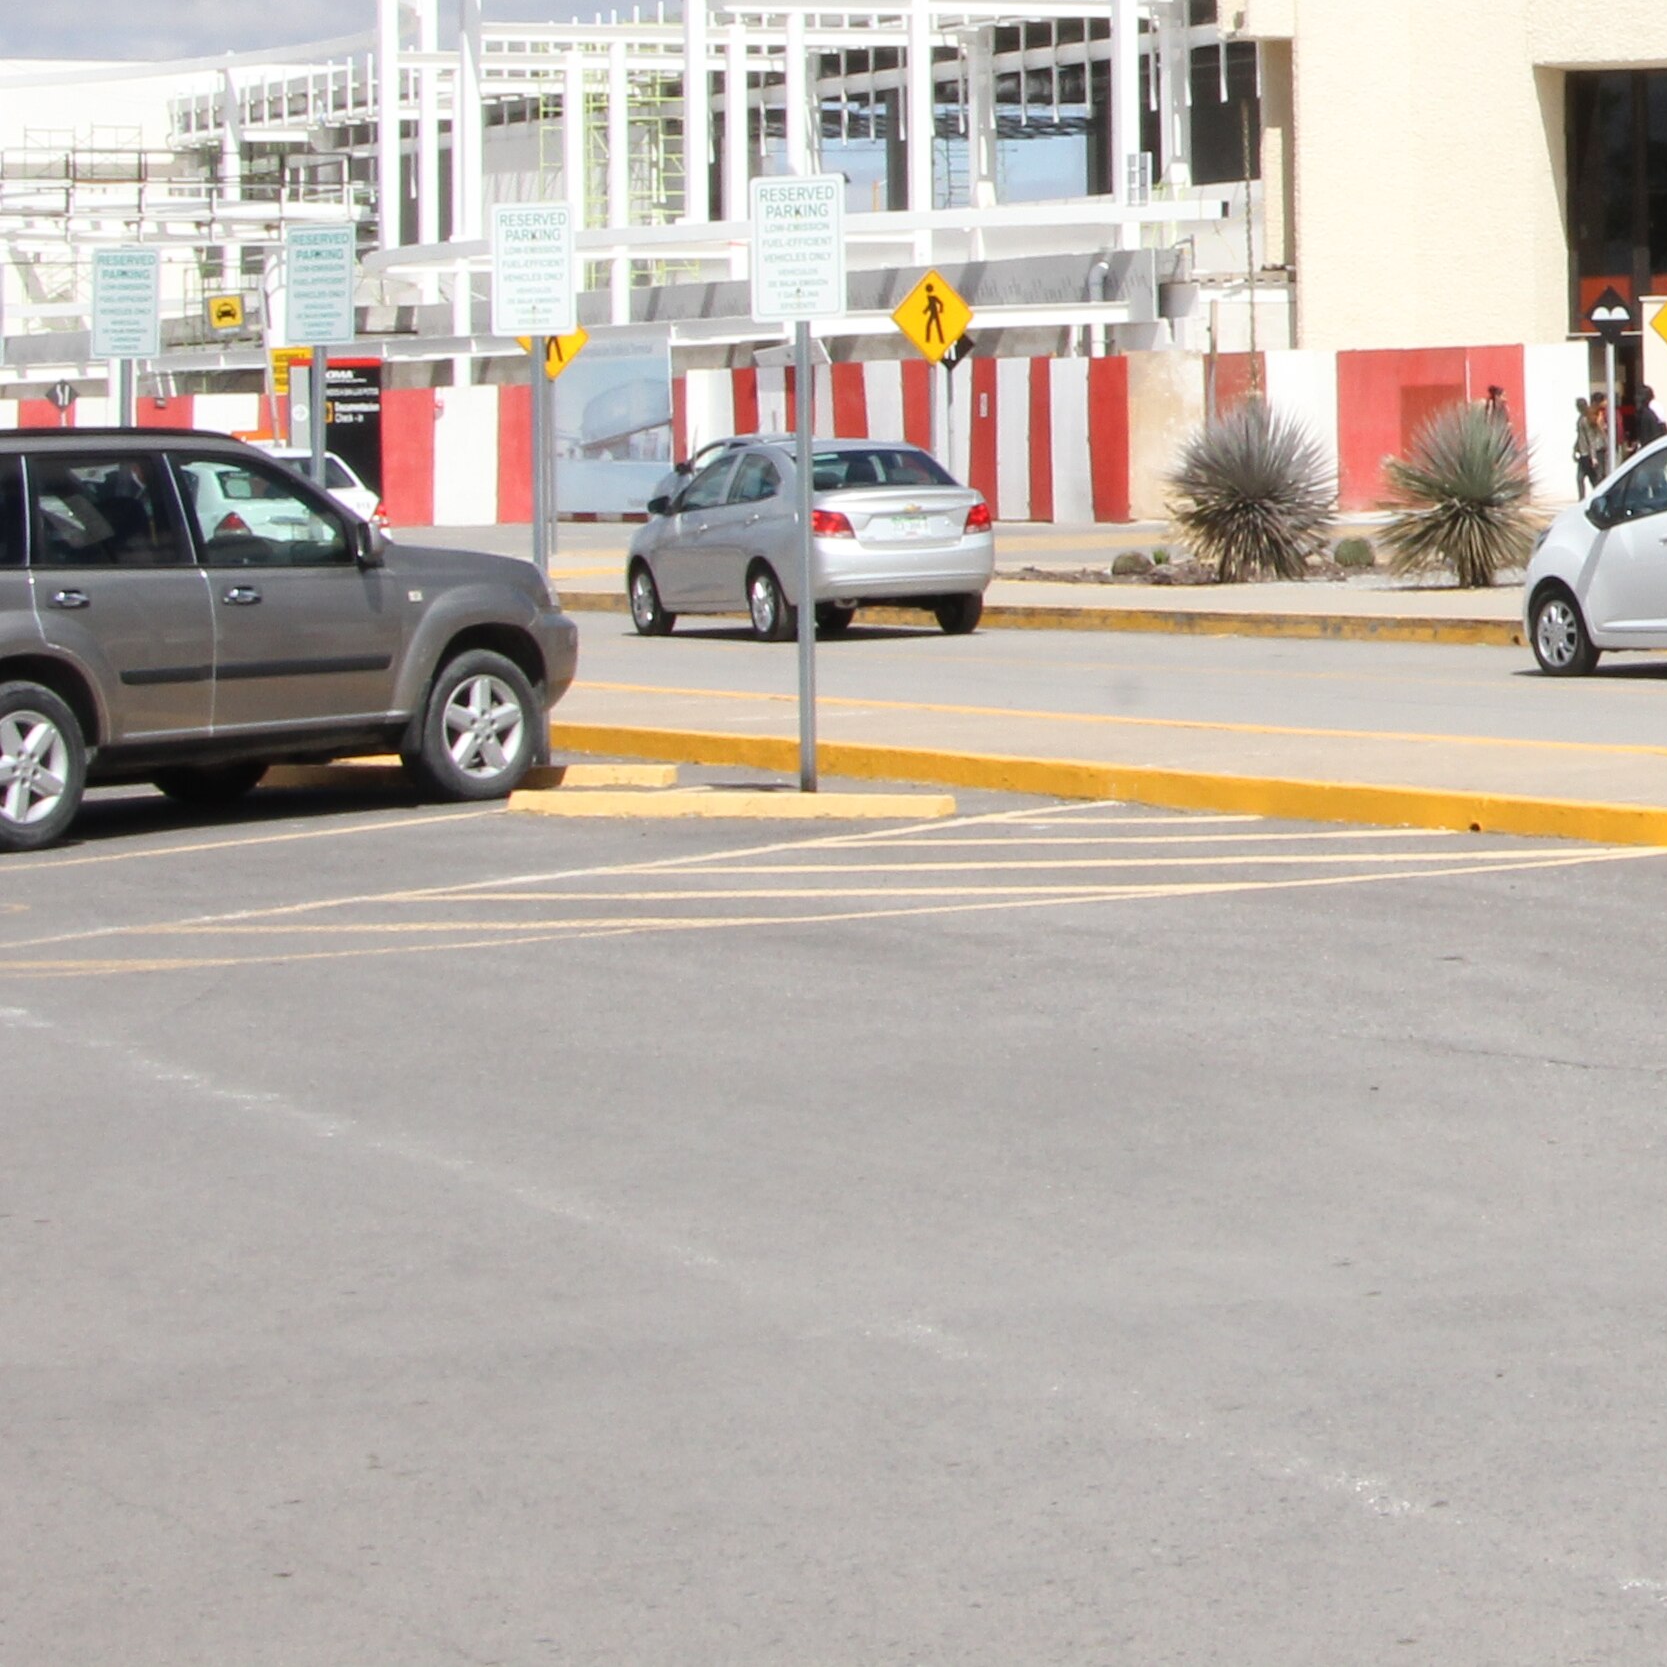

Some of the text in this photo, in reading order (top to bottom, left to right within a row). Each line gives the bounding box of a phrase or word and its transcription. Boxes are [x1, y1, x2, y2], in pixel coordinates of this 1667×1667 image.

[759, 185, 835, 202] RESERVED
[765, 203, 829, 219] PARKING
[499, 212, 567, 228] RESERVED
[764, 222, 830, 233] LOW-EMISSION
[290, 233, 350, 245] RESERVED
[504, 228, 562, 242] PARKING
[762, 236, 833, 248] FUEL-EFFICIENT
[763, 252, 832, 263] VEHICLES ONLY
[325, 369, 354, 379] OMA
